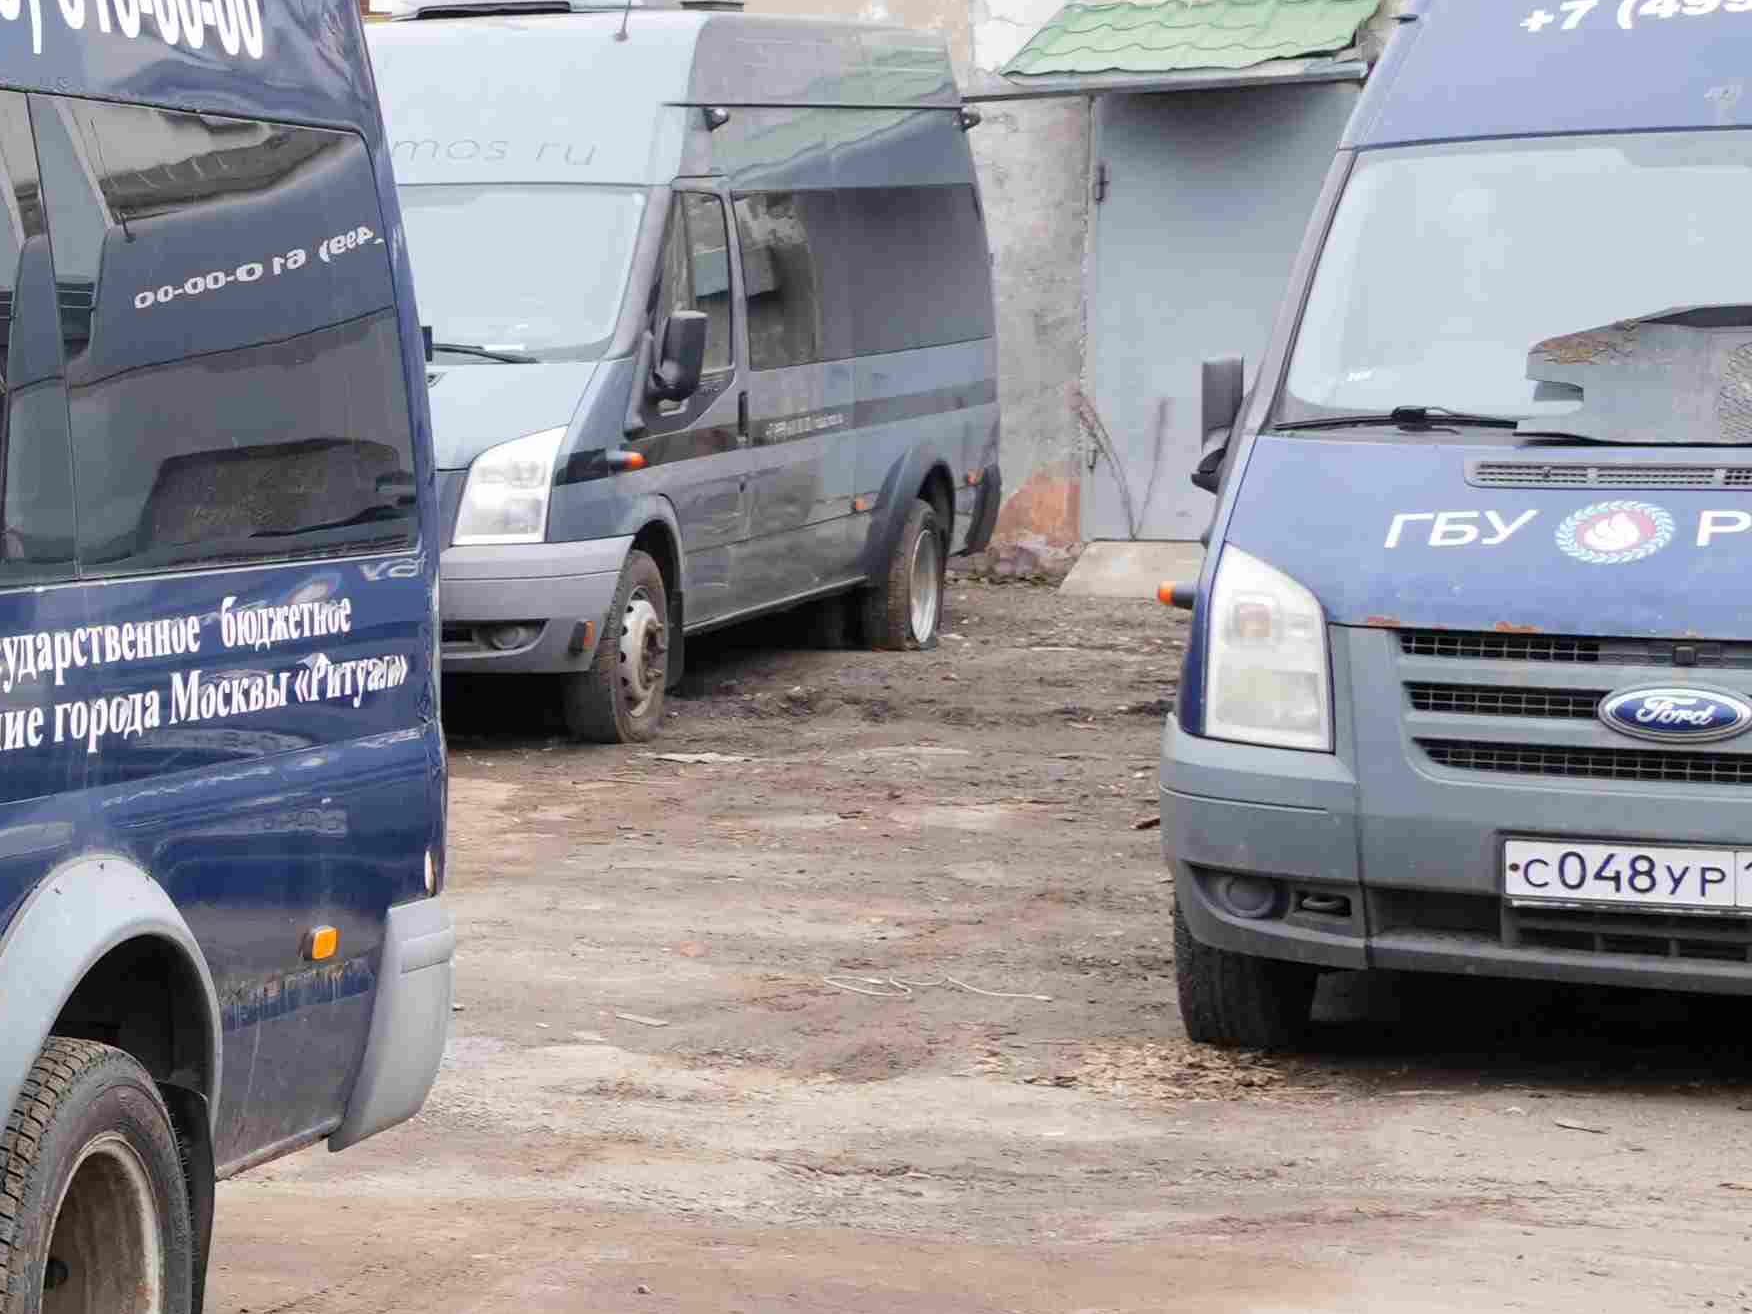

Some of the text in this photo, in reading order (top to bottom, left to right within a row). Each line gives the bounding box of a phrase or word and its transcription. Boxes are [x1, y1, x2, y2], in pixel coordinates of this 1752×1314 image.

[1384, 509, 1540, 549] ГБУ
[221, 596, 352, 651] бюджетное
[54, 691, 160, 752] города
[170, 671, 289, 725] Москвы
[1635, 696, 1715, 725] Ford
[1523, 851, 1727, 898] С048УР
